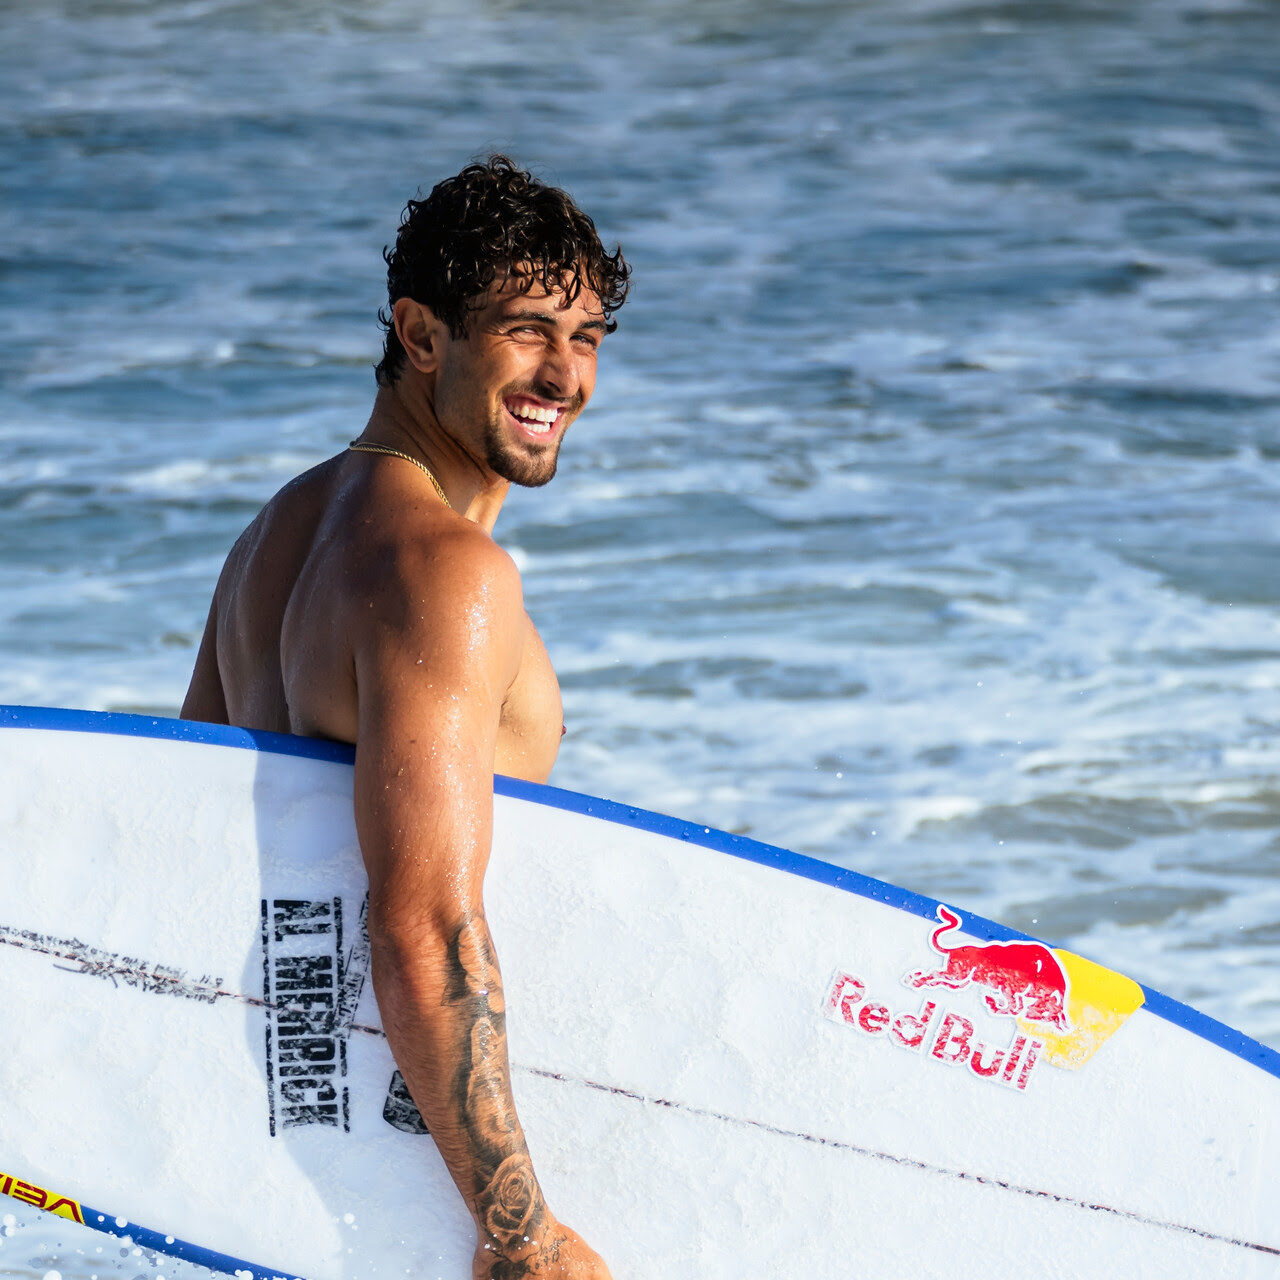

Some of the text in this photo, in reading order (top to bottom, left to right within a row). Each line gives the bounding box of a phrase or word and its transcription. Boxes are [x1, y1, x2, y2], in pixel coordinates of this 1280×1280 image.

[273, 899, 338, 1128] AL MERRICK
[823, 970, 1043, 1090] Red Bull
